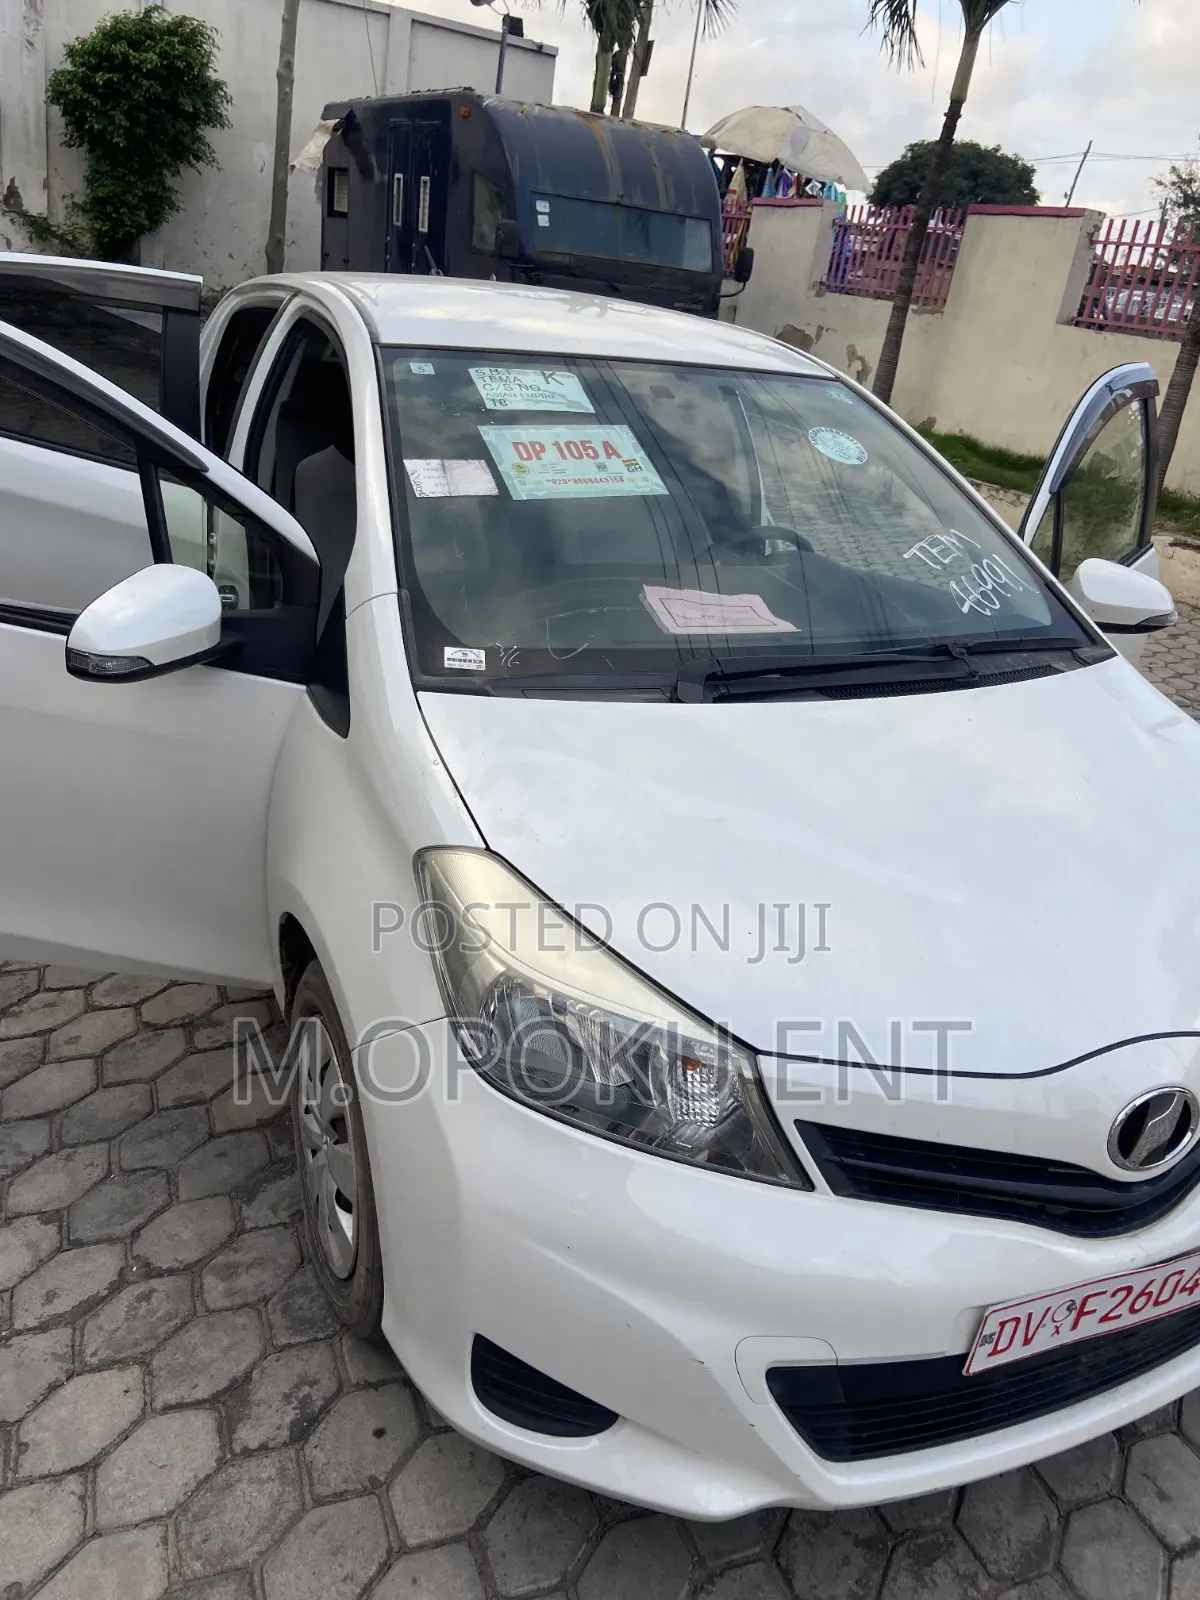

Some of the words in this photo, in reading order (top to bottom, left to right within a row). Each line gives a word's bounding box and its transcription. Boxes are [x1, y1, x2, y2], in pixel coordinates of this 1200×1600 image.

[478, 375, 524, 383] TEMA
[511, 441, 546, 461] DP
[551, 440, 600, 461] 105
[600, 440, 623, 460] A
[626, 465, 644, 473] GH
[987, 1306, 1052, 1358] DV
